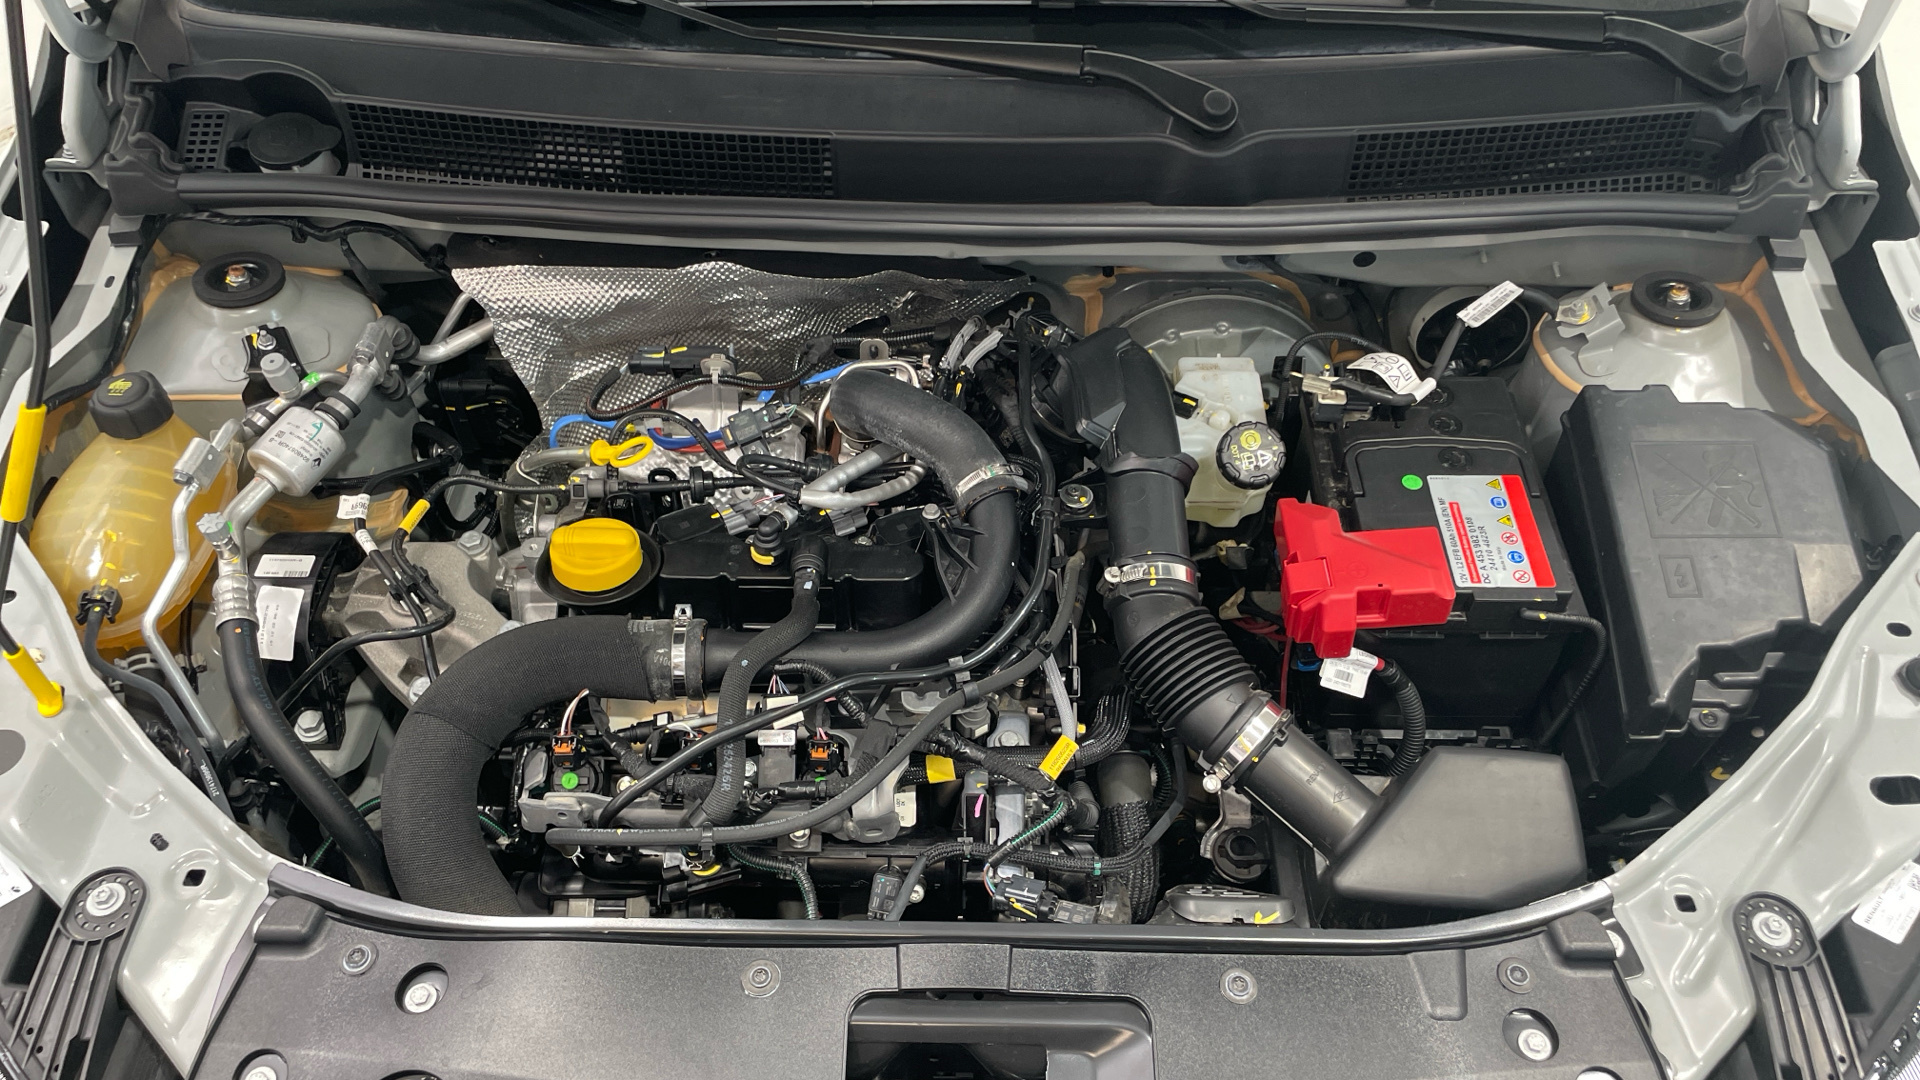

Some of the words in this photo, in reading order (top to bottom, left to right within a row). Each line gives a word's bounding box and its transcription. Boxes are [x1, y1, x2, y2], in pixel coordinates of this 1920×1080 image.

[1231, 445, 1240, 458] DOT
[1437, 497, 1447, 506] MF
[1444, 518, 1454, 533] 510A
[1470, 534, 1481, 548] 982
[1452, 549, 1462, 561] EFB
[1475, 550, 1485, 563] 453
[1456, 561, 1465, 569] L2
[1459, 572, 1469, 584] 12V
[1481, 573, 1491, 584] DC
